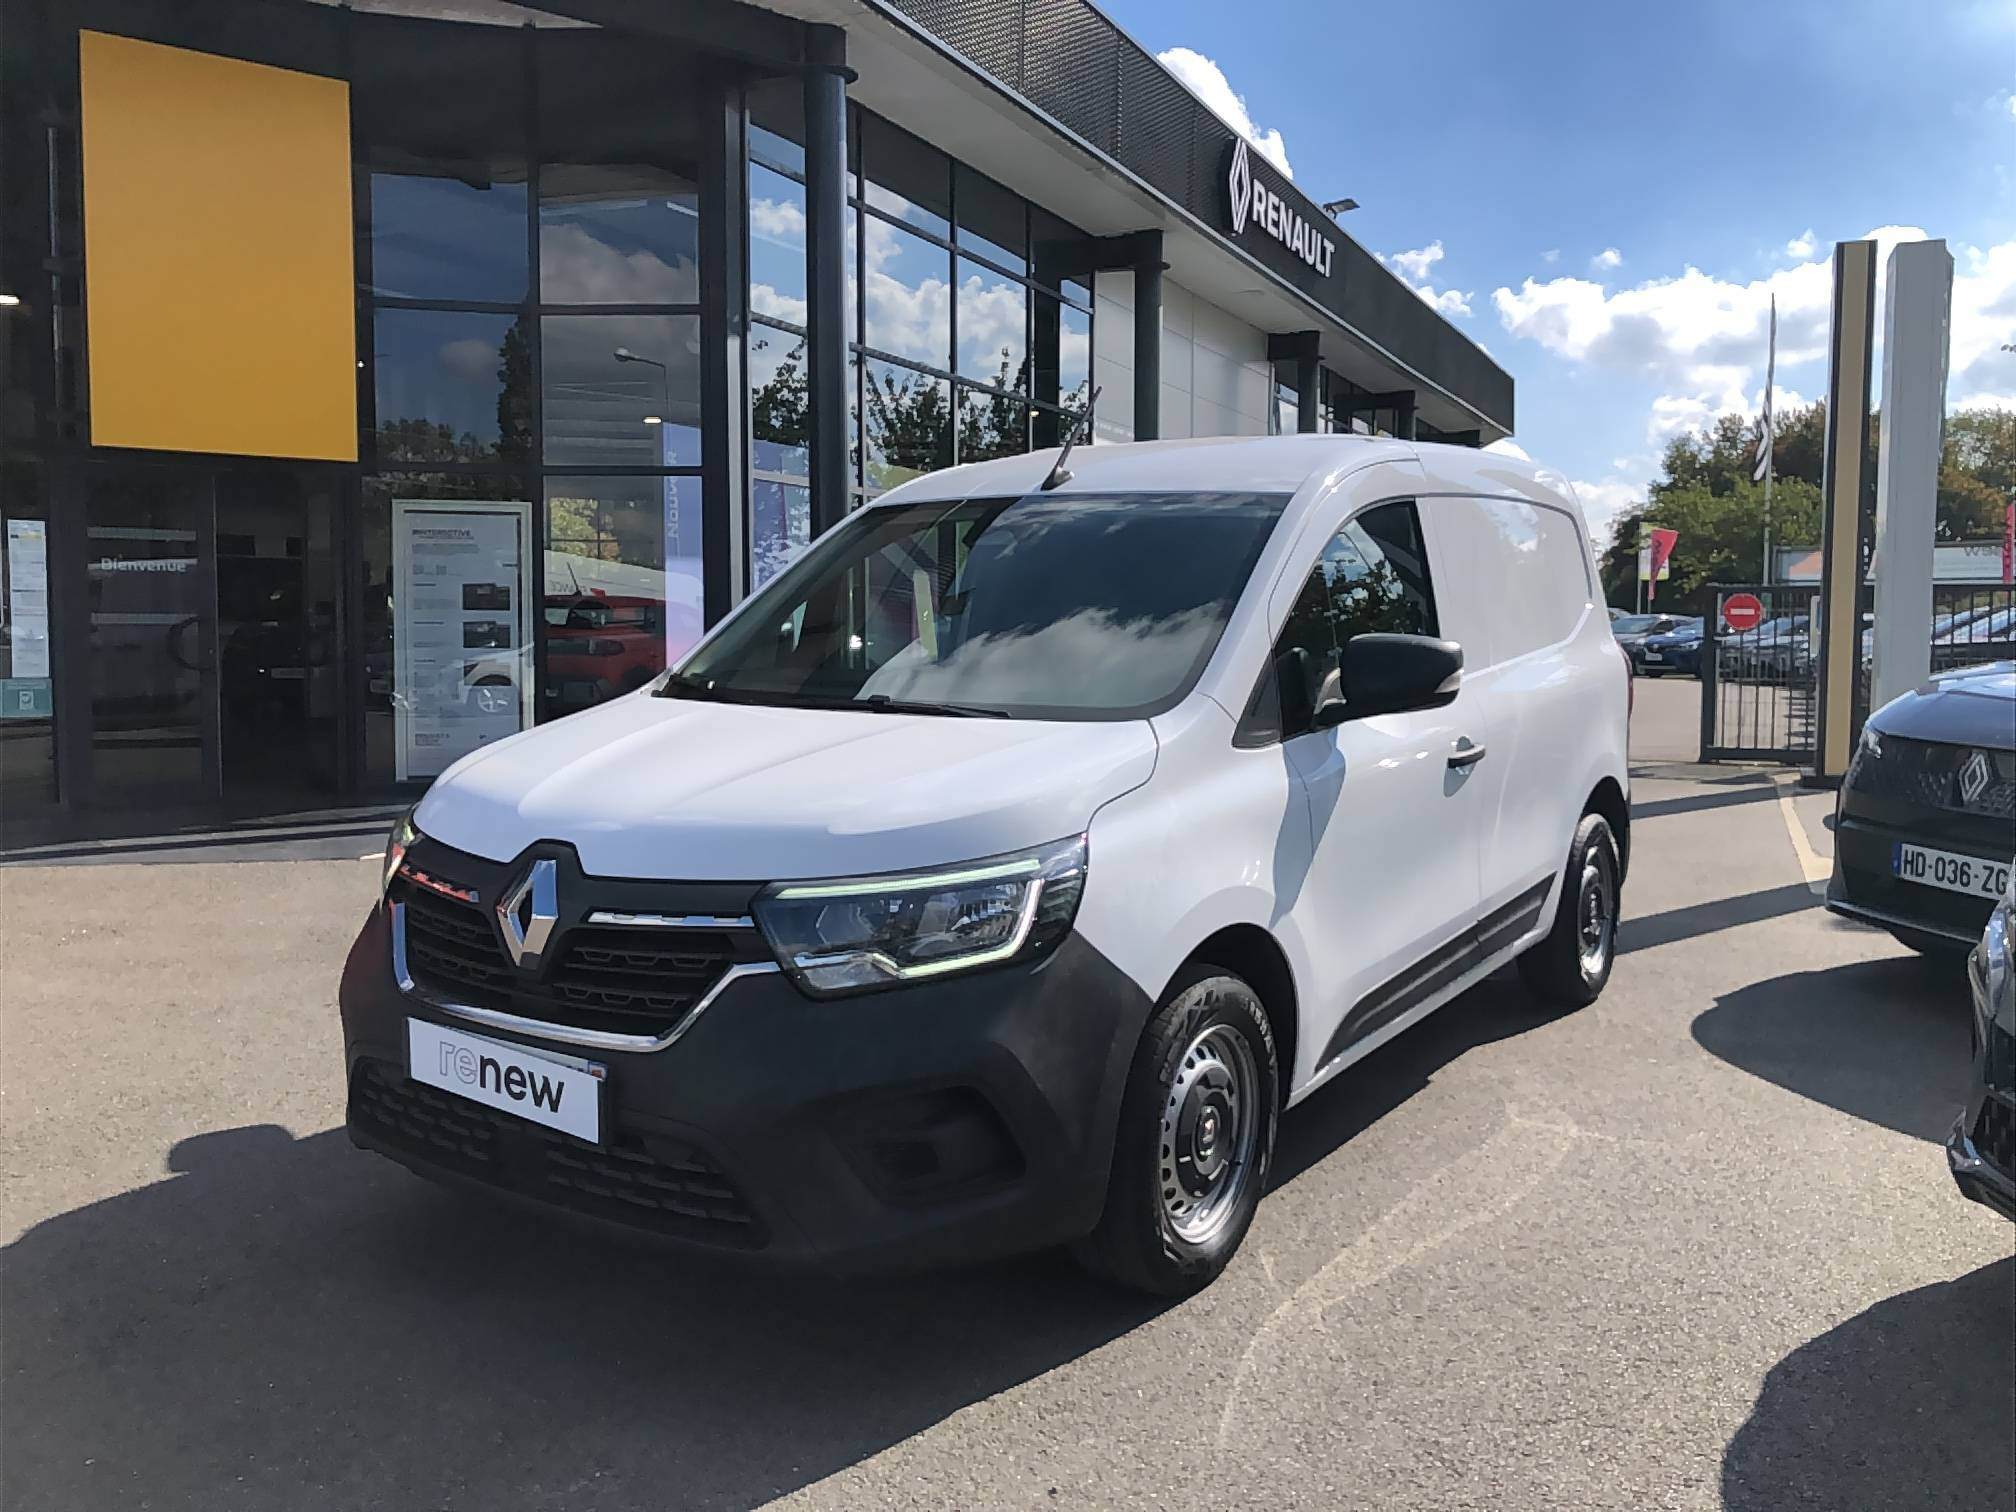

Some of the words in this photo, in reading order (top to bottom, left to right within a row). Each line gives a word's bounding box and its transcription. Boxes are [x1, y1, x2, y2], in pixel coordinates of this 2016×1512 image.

[1252, 178, 1336, 278] RENAULT
[101, 557, 187, 573] Bienvenue
[1903, 848, 2009, 896] HD-036-ZG
[439, 1041, 565, 1113] renew
